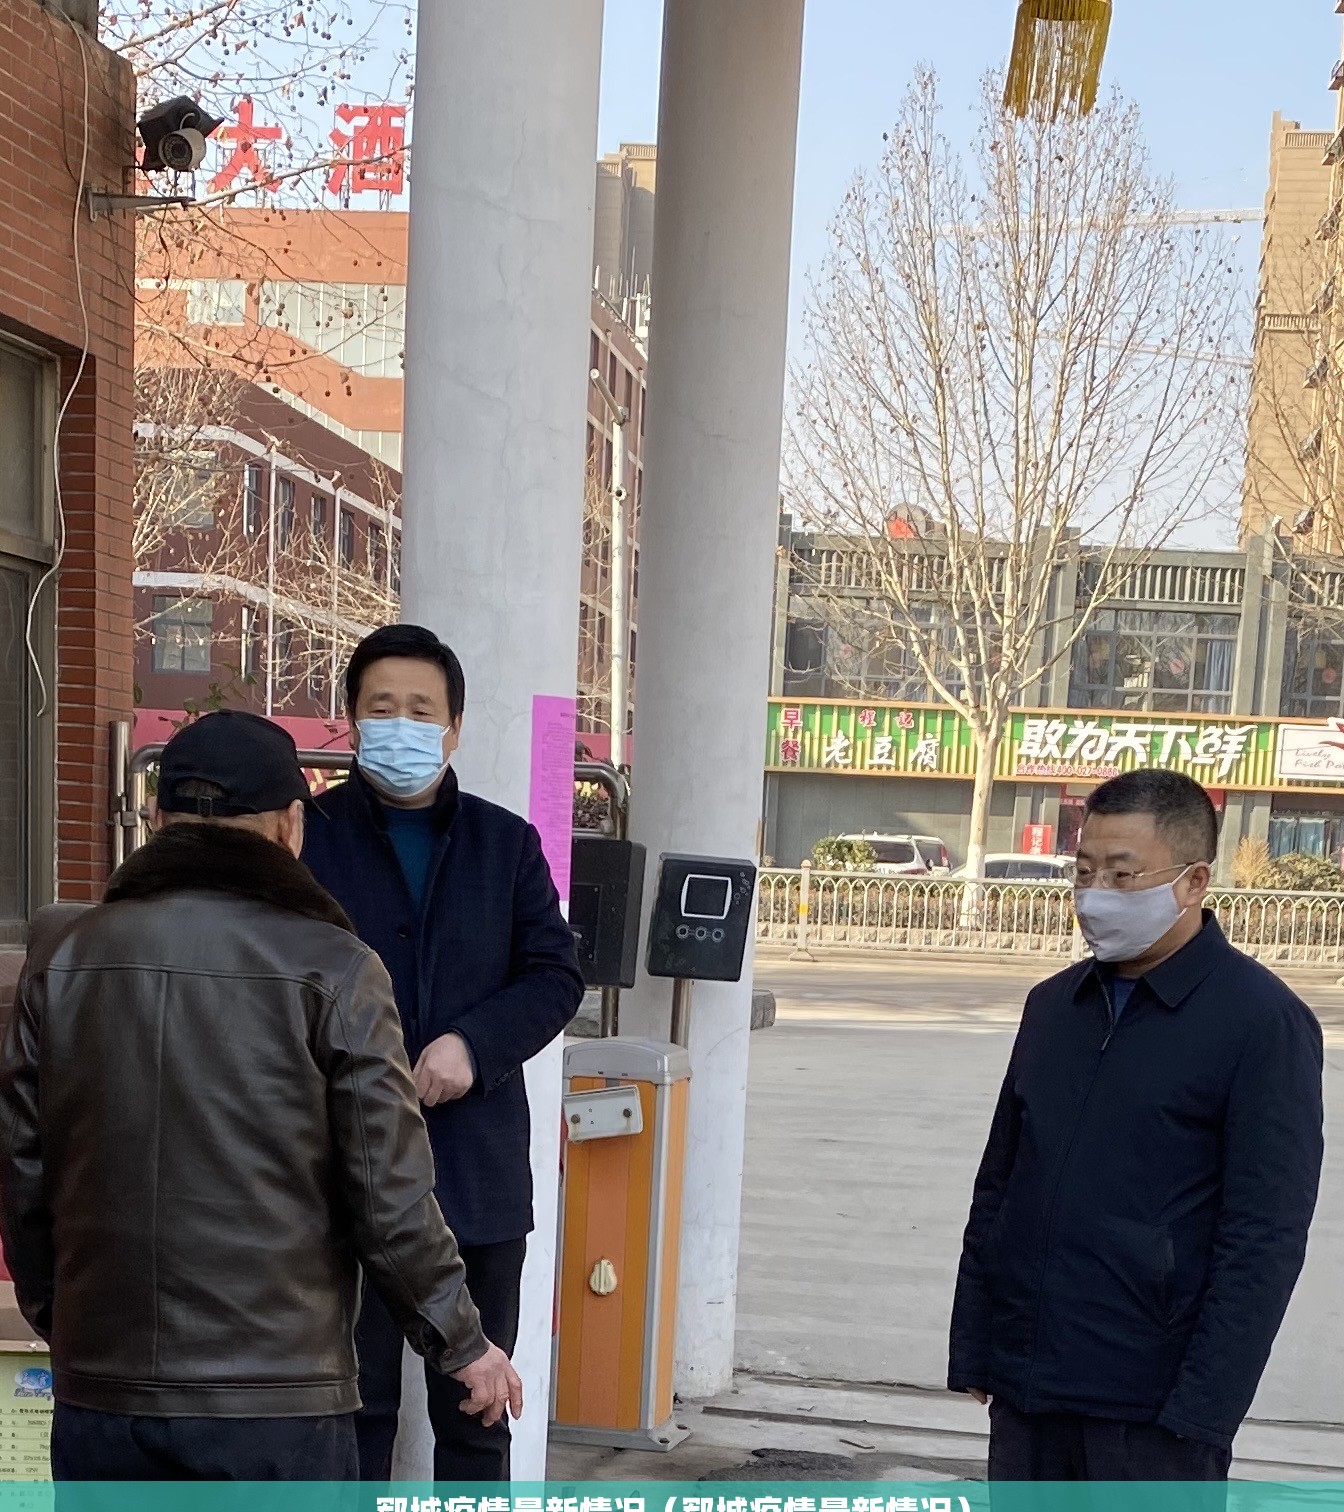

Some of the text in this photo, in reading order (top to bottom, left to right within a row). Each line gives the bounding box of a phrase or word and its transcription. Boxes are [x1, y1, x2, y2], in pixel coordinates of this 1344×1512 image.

[136, 98, 406, 196] 大酒
[781, 707, 803, 762] 早餐
[825, 730, 940, 769] 老豆腐
[1018, 718, 1258, 779] 敢为天下鲜
